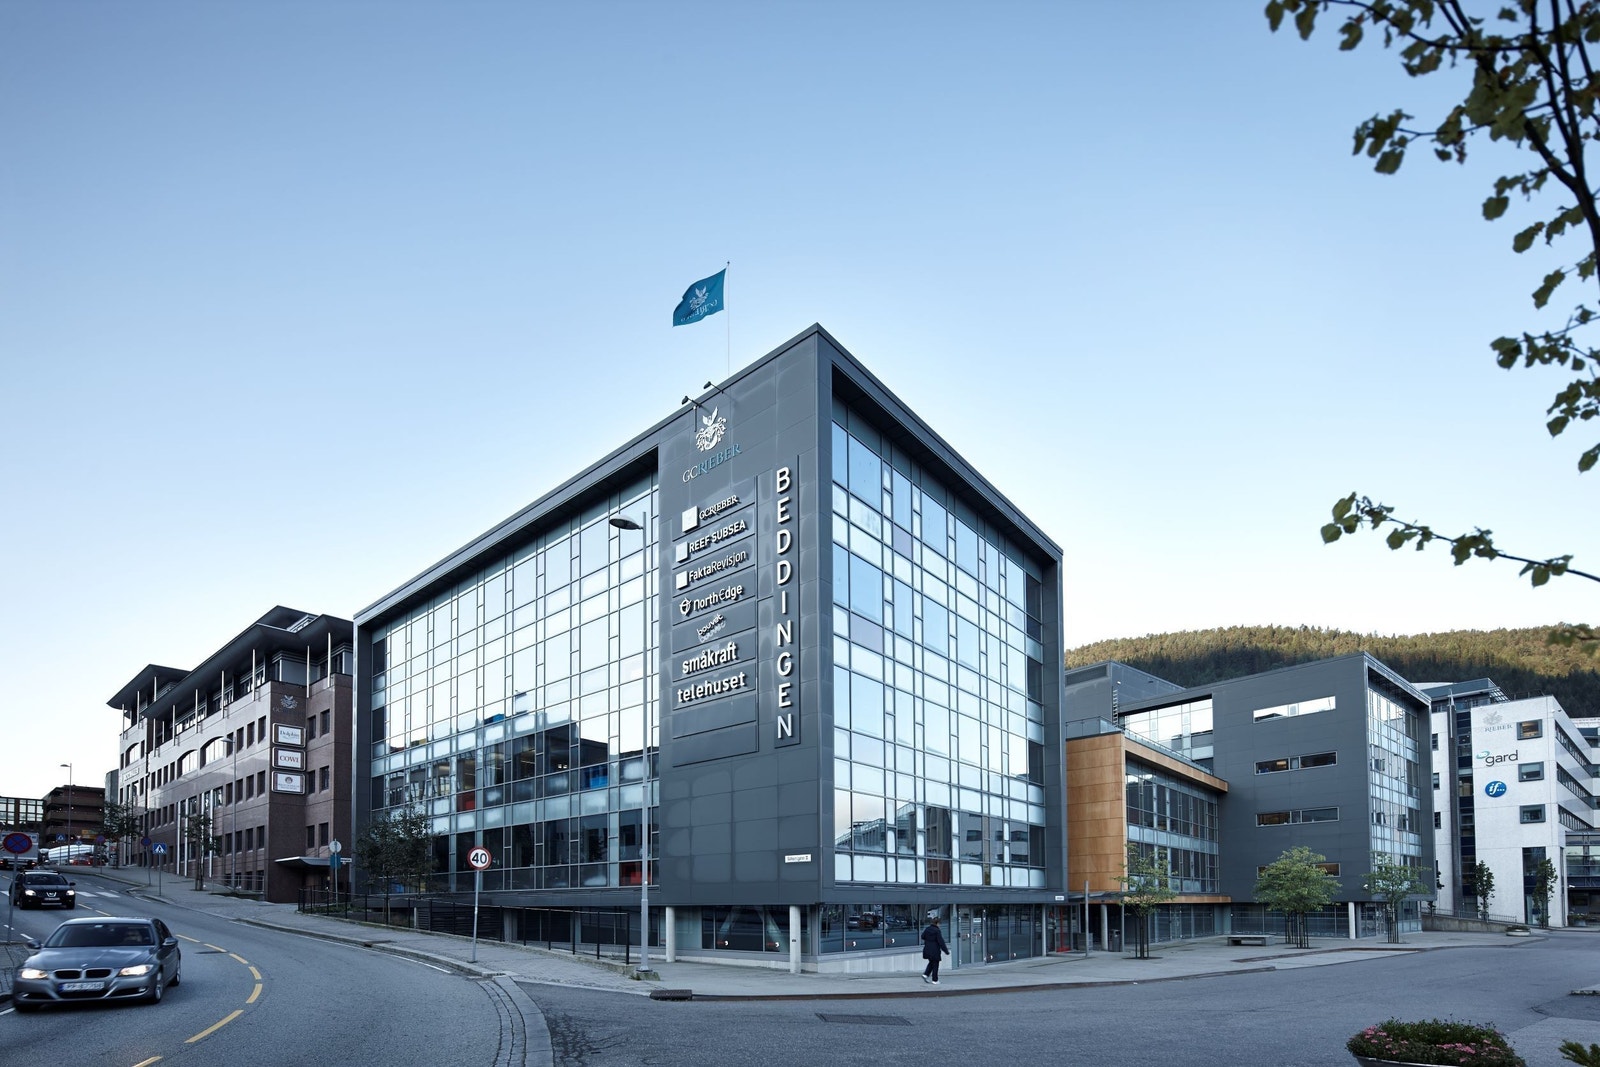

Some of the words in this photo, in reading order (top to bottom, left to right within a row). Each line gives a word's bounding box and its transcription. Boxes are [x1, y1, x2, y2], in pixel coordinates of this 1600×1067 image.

[689, 535, 710, 553] REEF
[711, 519, 746, 543] SUBSEA
[688, 550, 747, 582] FaktaRevisjon
[776, 466, 793, 739] BEDDINGEN
[682, 641, 737, 674] småkraft
[677, 671, 745, 703] telehuset
[279, 755, 299, 763] COWI
[1485, 749, 1519, 767] gard
[471, 852, 488, 865] 40
